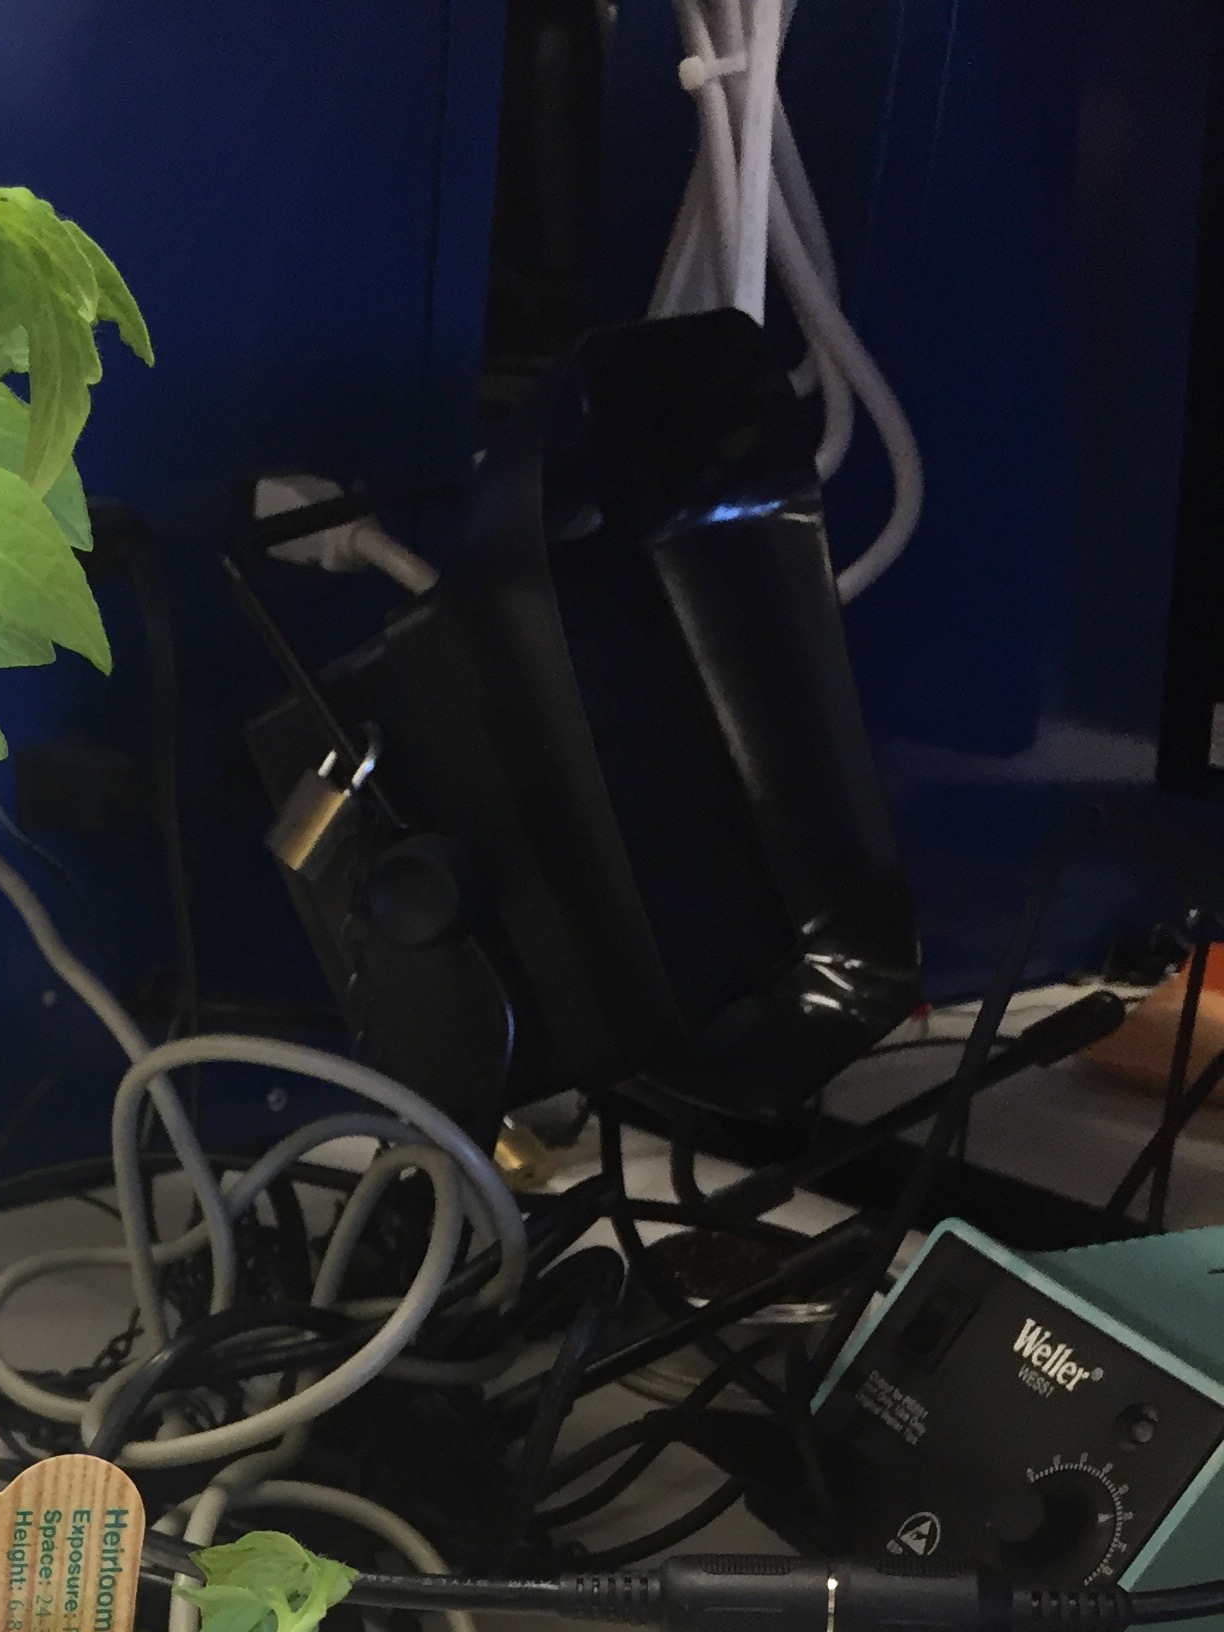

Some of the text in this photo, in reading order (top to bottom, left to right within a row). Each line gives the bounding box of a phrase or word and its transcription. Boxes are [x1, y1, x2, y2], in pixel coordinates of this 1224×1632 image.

[1013, 1317, 1091, 1392] Weller
[7, 1510, 34, 1591] Height:
[36, 1509, 63, 1585] Space:
[63, 1509, 91, 1619] Exposure:
[93, 1508, 129, 1632] Heirloom
